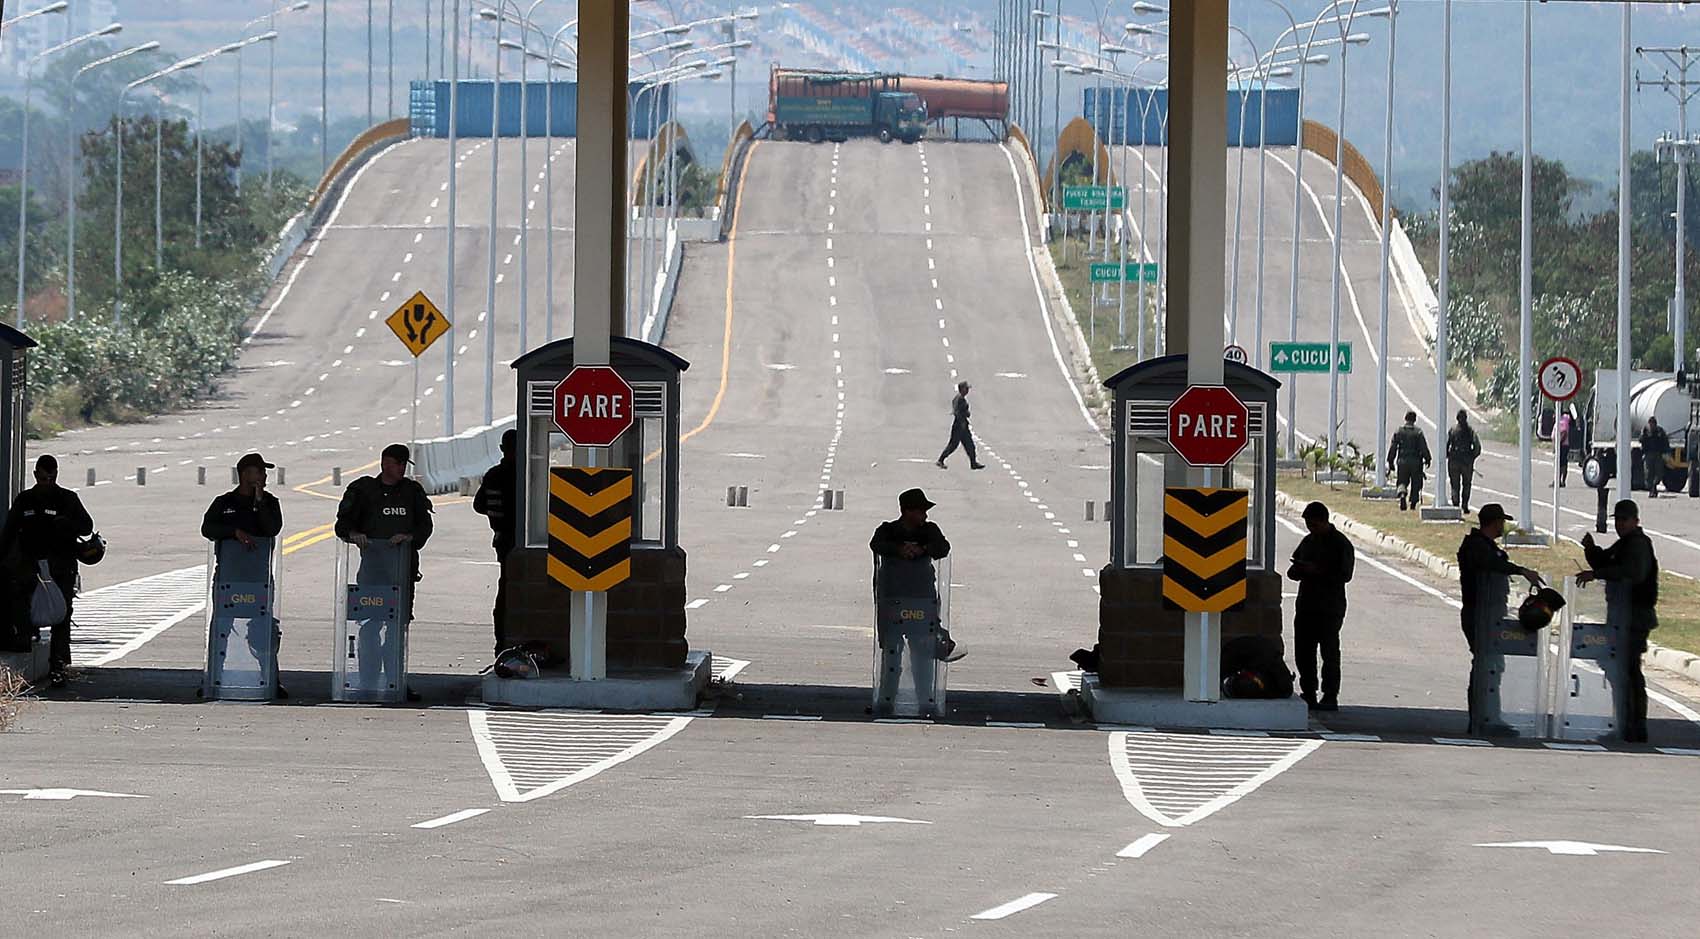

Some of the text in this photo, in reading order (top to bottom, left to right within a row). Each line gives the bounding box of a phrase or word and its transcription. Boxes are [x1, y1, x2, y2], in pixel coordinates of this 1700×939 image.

[1225, 351, 1242, 360] 40
[1291, 350, 1347, 366] CUCUA
[563, 394, 623, 418] PARE
[1178, 414, 1238, 438] PARE
[382, 507, 407, 516] GNB
[231, 594, 256, 604] GNB
[359, 596, 384, 606] GNB
[900, 609, 925, 620] GNB
